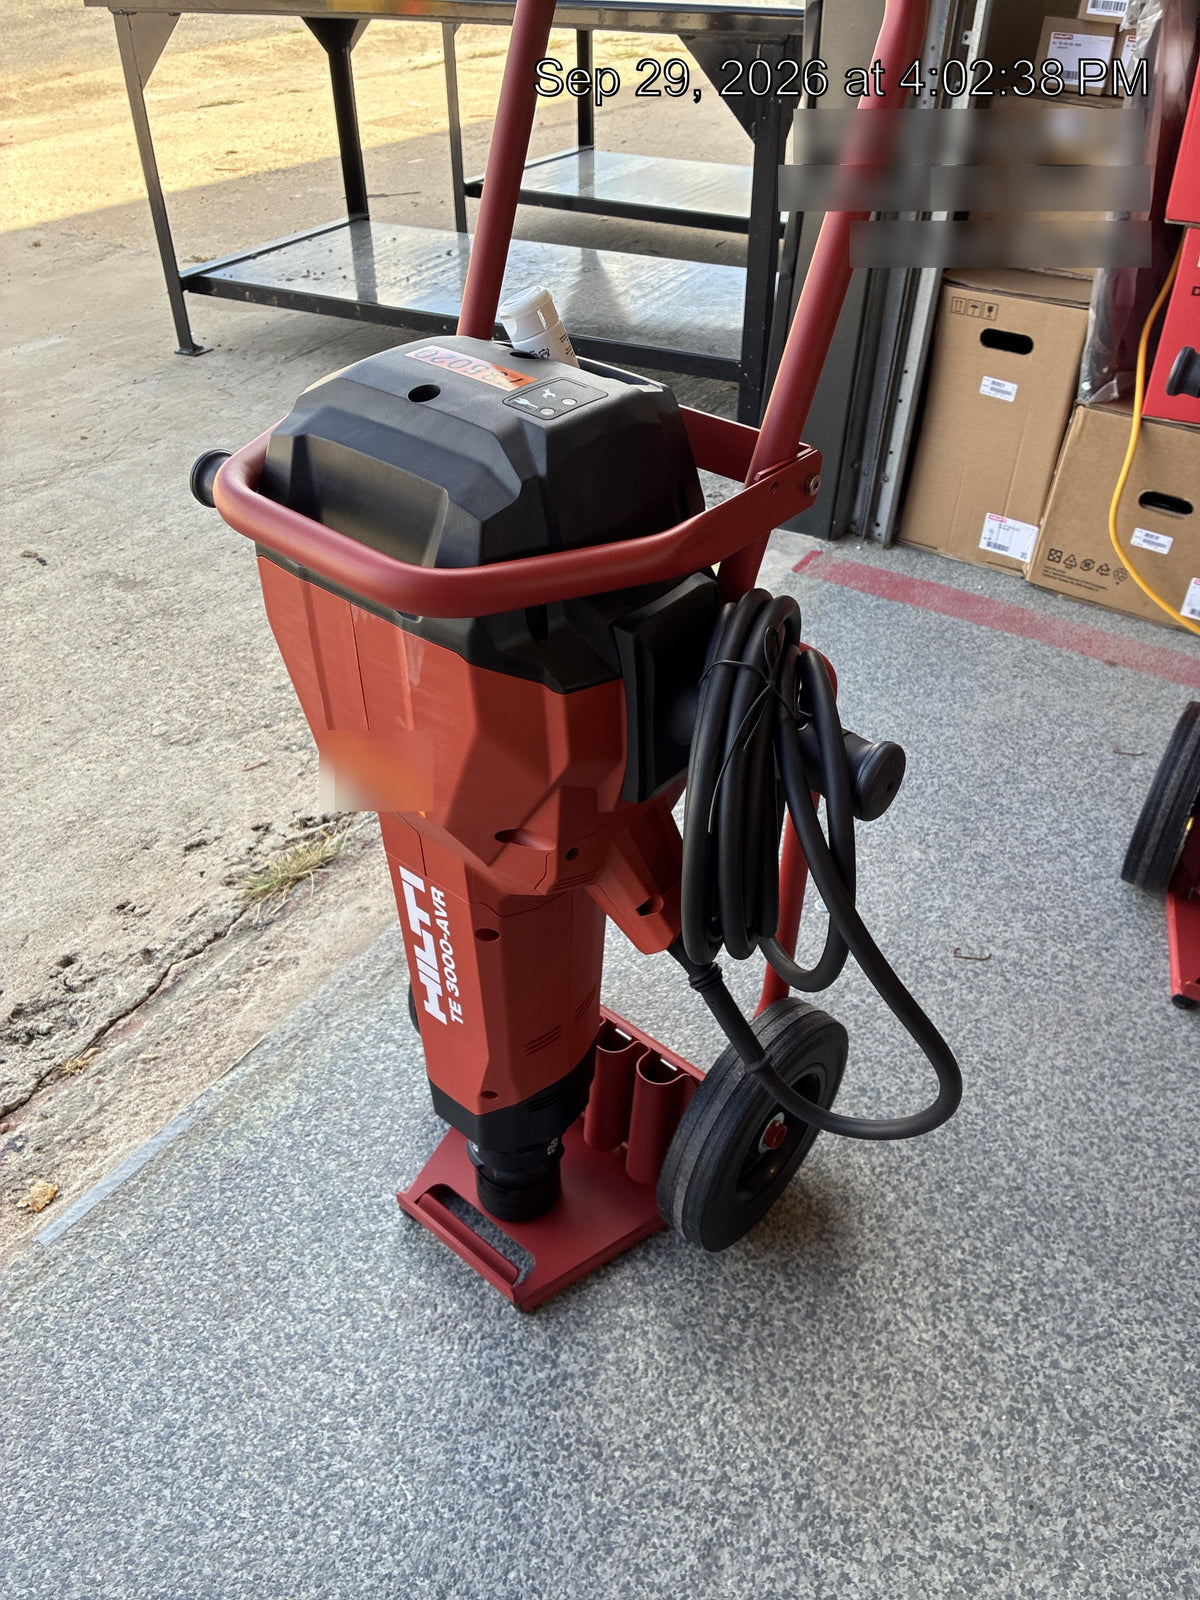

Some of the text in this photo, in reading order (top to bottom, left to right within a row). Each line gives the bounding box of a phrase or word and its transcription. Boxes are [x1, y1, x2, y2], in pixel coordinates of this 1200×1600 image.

[399, 865, 447, 1026] HILTI
[431, 886, 463, 1024] TE 3000-AVR
